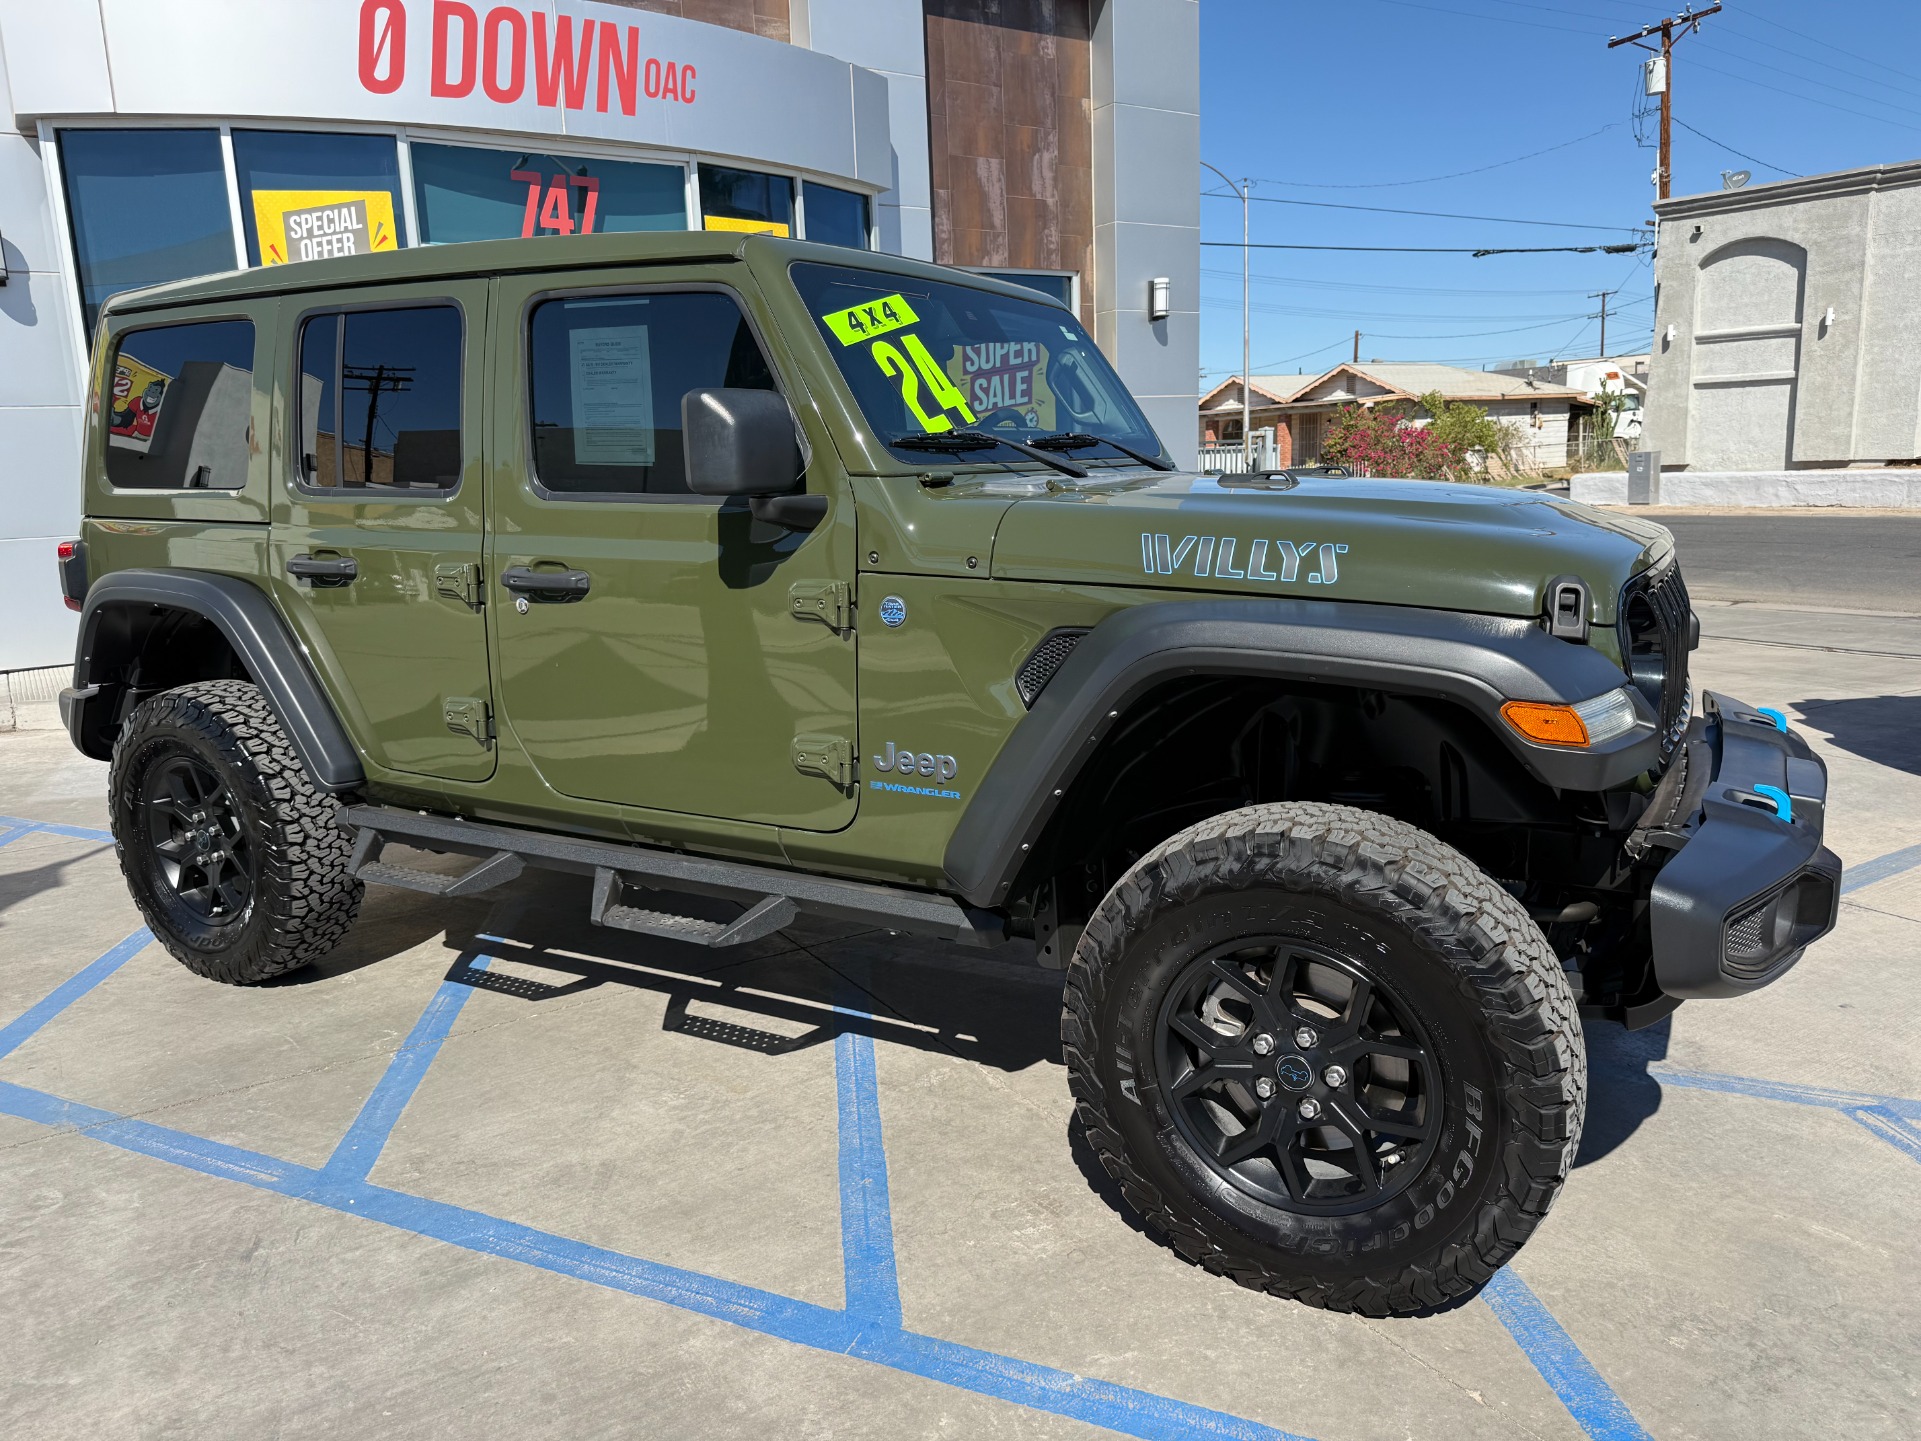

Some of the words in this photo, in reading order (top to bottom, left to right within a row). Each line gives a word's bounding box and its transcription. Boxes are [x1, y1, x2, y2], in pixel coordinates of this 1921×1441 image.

[431, 0, 640, 117] DOWN
[644, 58, 697, 104] OAC
[289, 206, 363, 239] SPECIAL
[511, 170, 600, 239] 747
[300, 232, 356, 261] OFFER
[965, 341, 1037, 373] SUPER
[871, 333, 978, 434] 24
[973, 370, 1028, 412] SALE
[1141, 533, 1349, 584] WILLYS
[873, 741, 958, 784] Jeep
